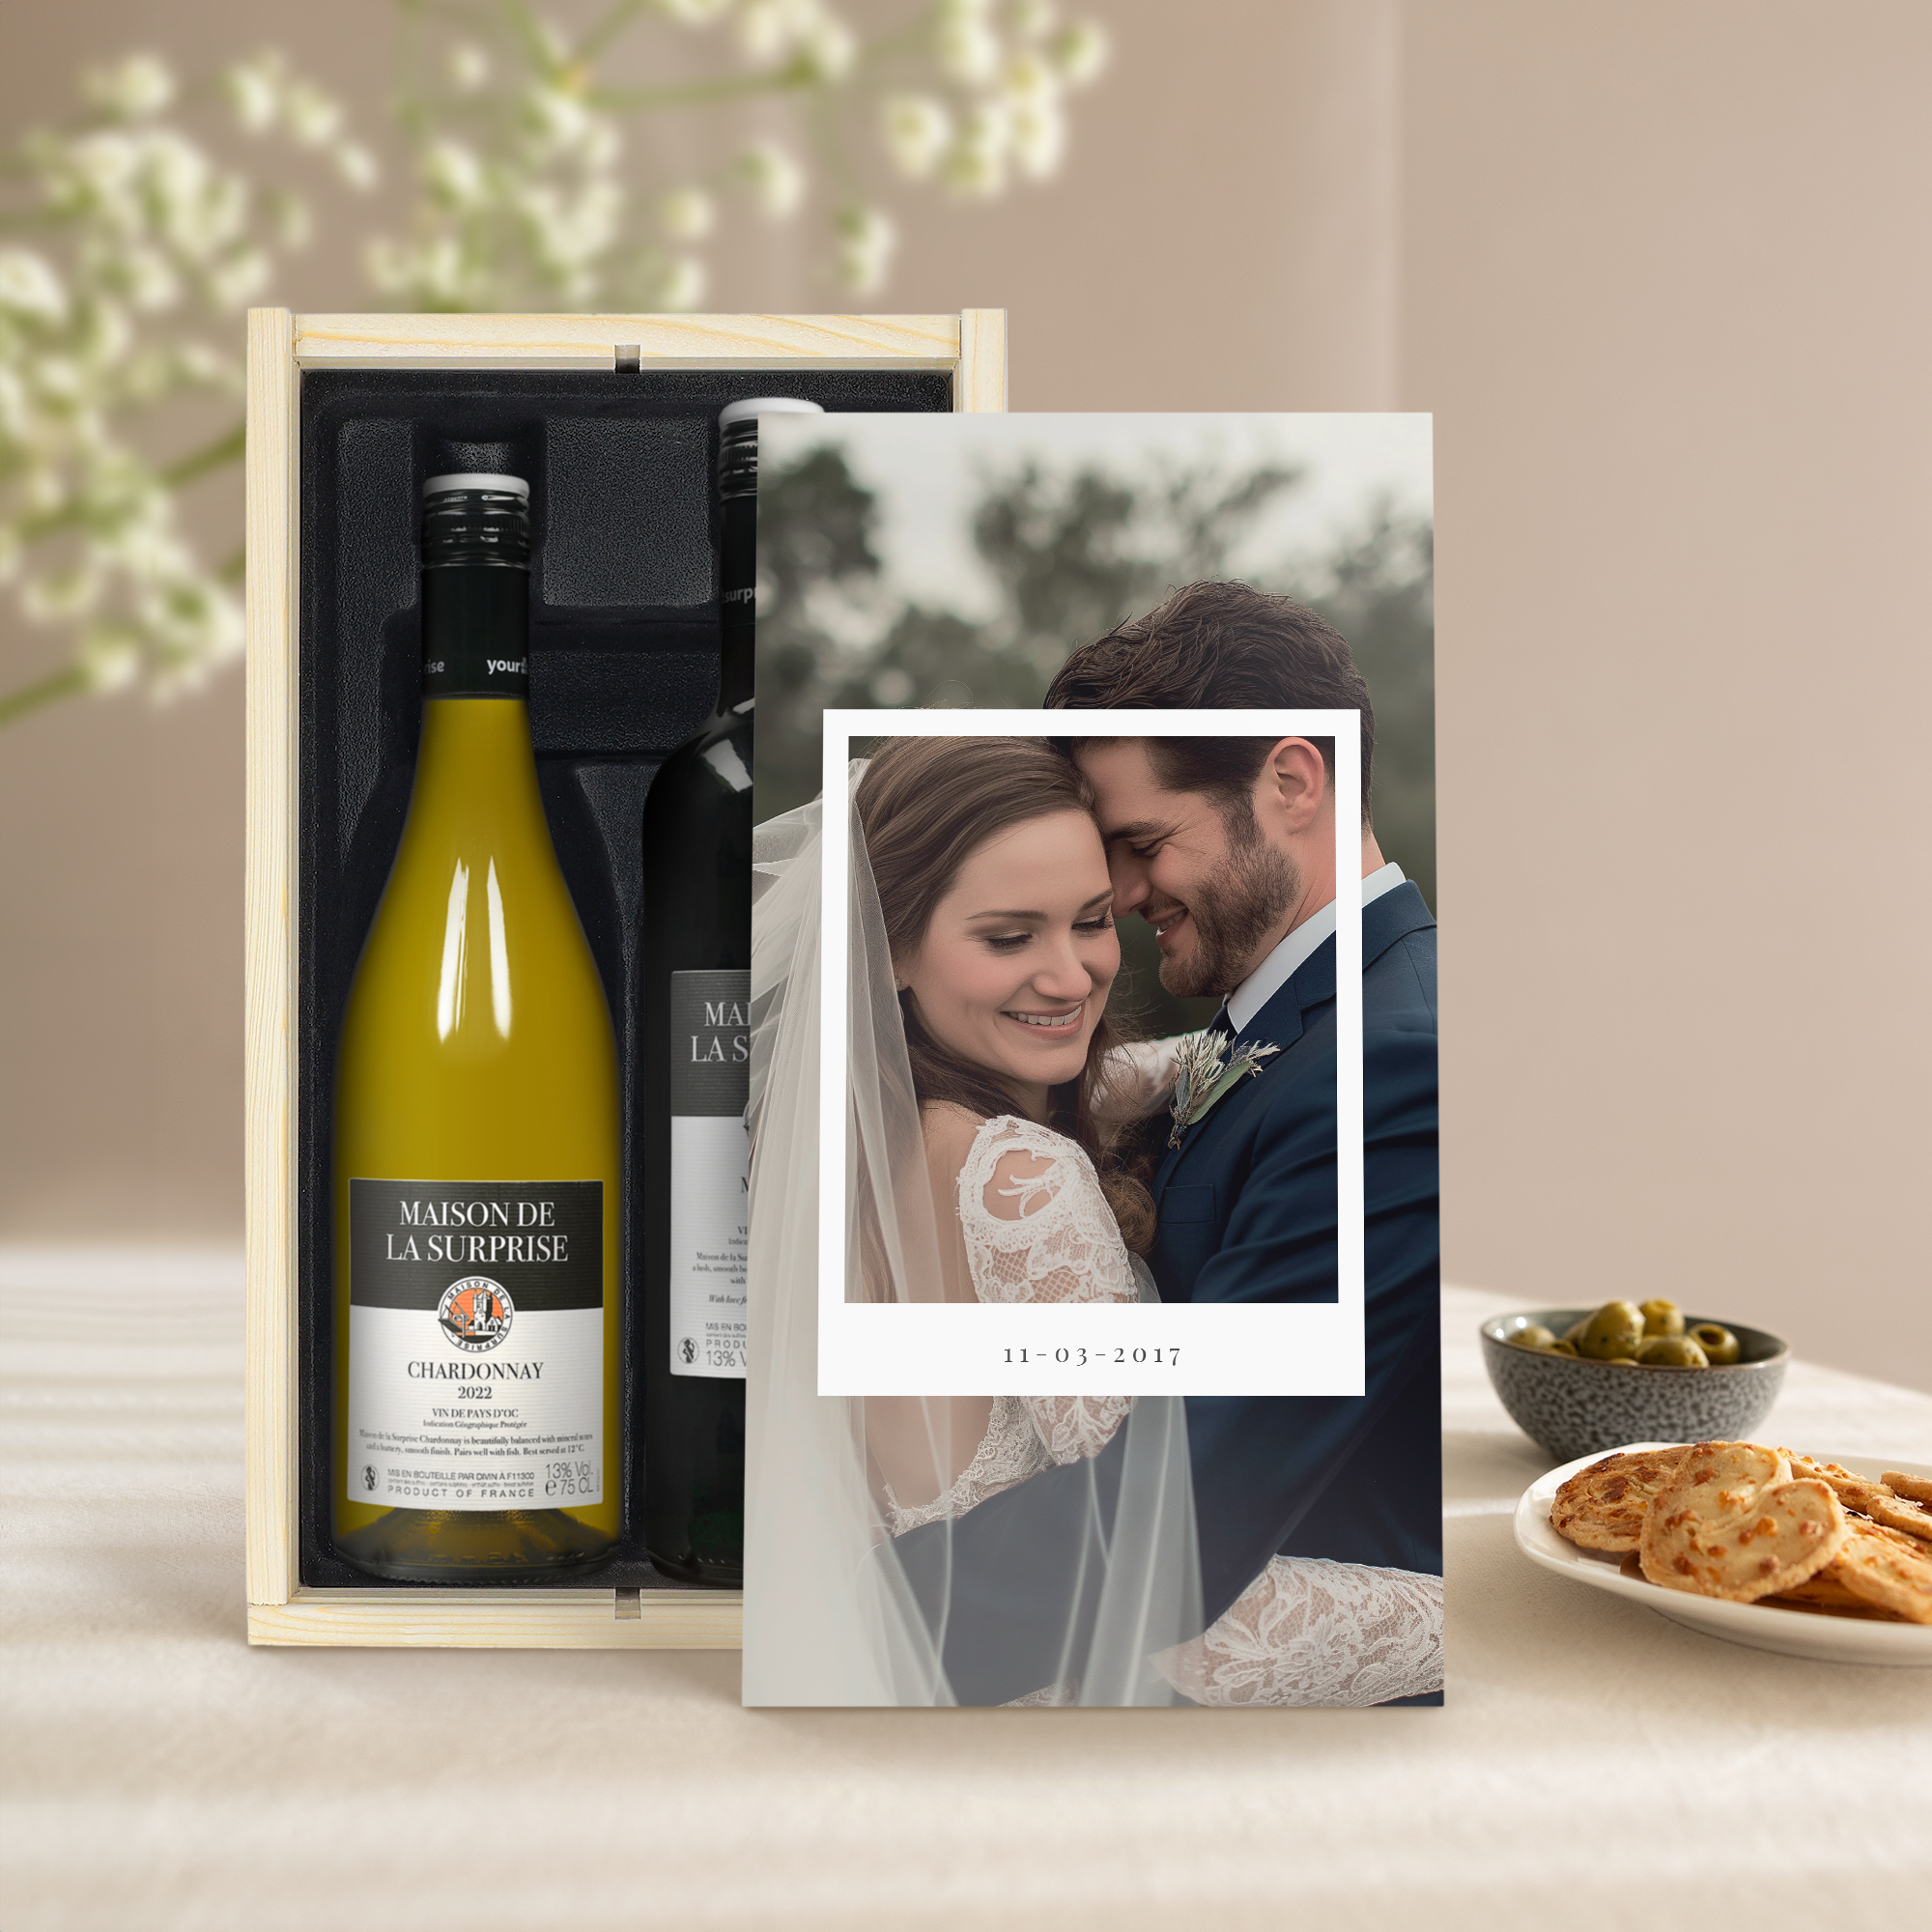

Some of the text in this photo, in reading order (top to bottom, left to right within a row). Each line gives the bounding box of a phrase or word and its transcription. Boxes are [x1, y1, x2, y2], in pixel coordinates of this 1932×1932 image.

[691, 1035, 726, 1063] LA
[399, 1201, 555, 1227] MAISON DE
[386, 1234, 569, 1263] LA SURPRISE
[696, 1252, 719, 1261] Maison
[709, 1294, 724, 1303] With
[447, 1281, 511, 1350] MAISON DE LA SURPRISE
[705, 1322, 720, 1331] MIS
[706, 1350, 736, 1367] 13%
[1004, 1348, 1180, 1367] 11-03-2017
[408, 1361, 544, 1380] CHARDONNAY
[457, 1386, 493, 1399] 2022
[432, 1407, 449, 1418] VIN
[451, 1408, 466, 1418] DE
[467, 1408, 492, 1418] PAYS
[423, 1419, 527, 1430] Indication Géographique Protégée
[391, 1433, 418, 1443] Surprise
[419, 1435, 462, 1447] Chardonnay
[471, 1436, 509, 1447] beautifully
[510, 1435, 541, 1444] balanced
[542, 1435, 556, 1443] with
[556, 1433, 578, 1442] mineral
[430, 1447, 452, 1456] finish.
[523, 1447, 538, 1456] Best
[539, 1446, 559, 1455] served
[387, 1468, 401, 1477] MIS
[401, 1469, 412, 1478] EN
[413, 1470, 456, 1480] BOUTEILLE
[545, 1462, 572, 1479] 13%
[387, 1485, 534, 1498] PRODUCT OF FRANCE
[560, 1478, 576, 1495] 75
